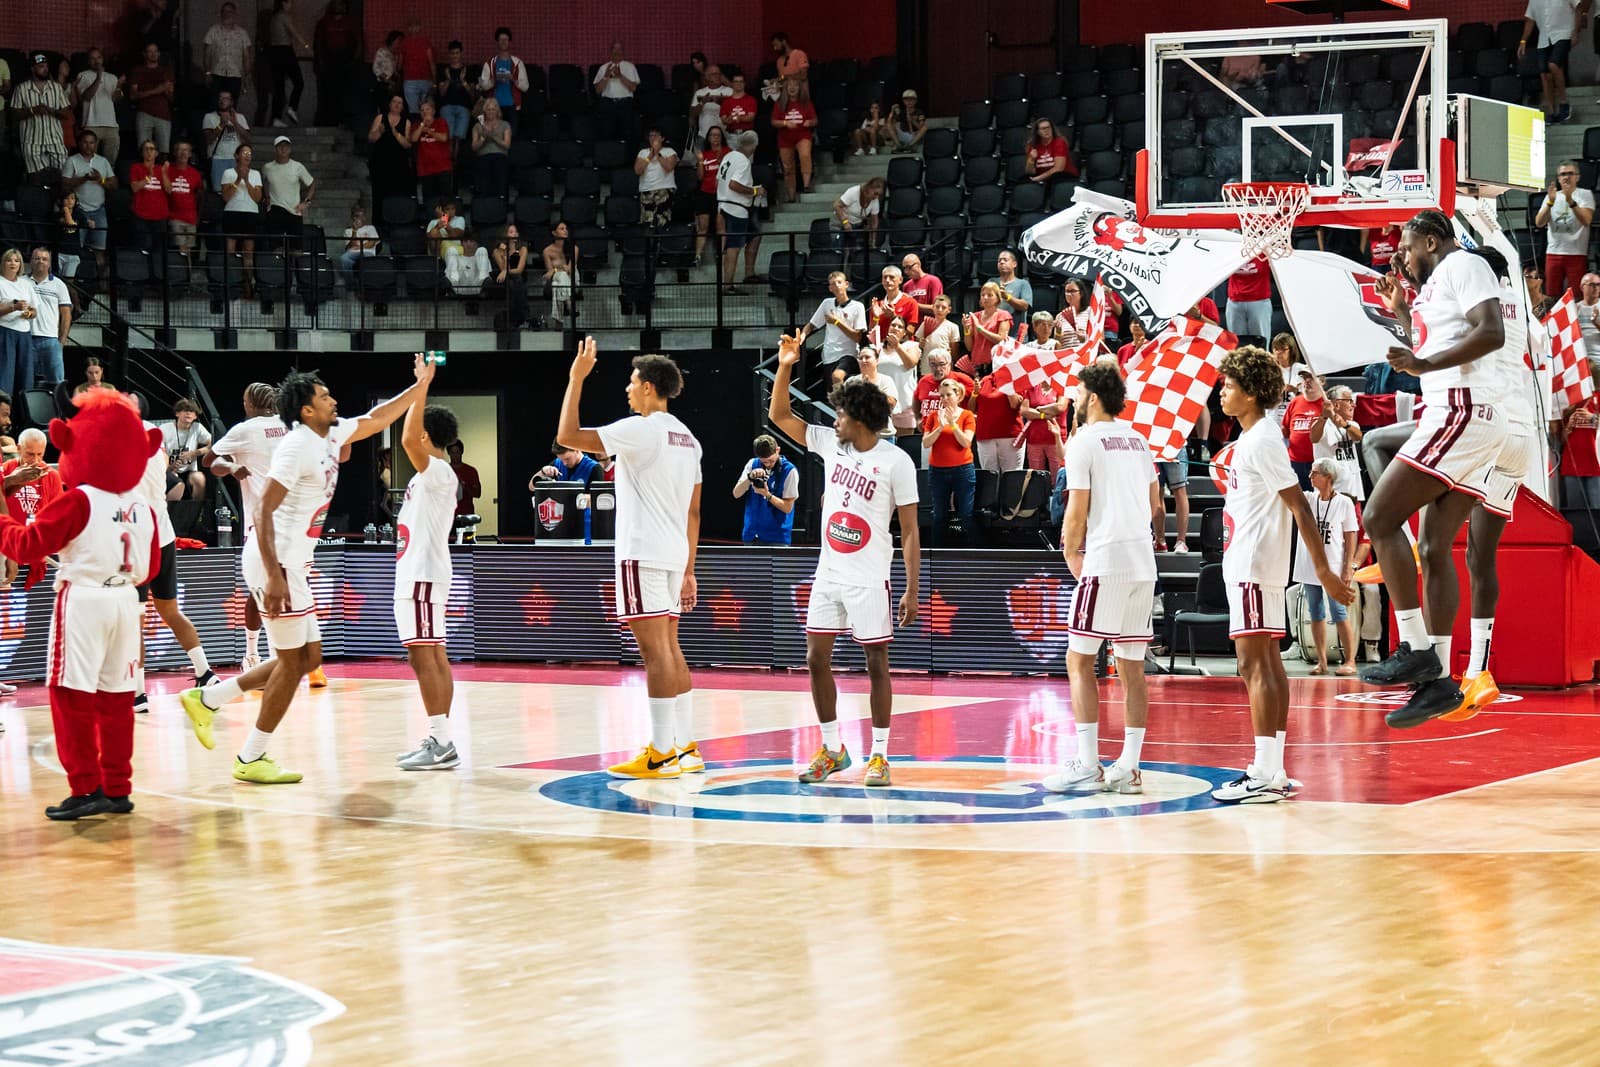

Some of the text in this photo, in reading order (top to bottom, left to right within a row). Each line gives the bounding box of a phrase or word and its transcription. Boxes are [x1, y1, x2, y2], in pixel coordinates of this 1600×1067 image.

[831, 463, 877, 502] BOURG
[842, 491, 851, 508] 3
[119, 532, 133, 573] 1
